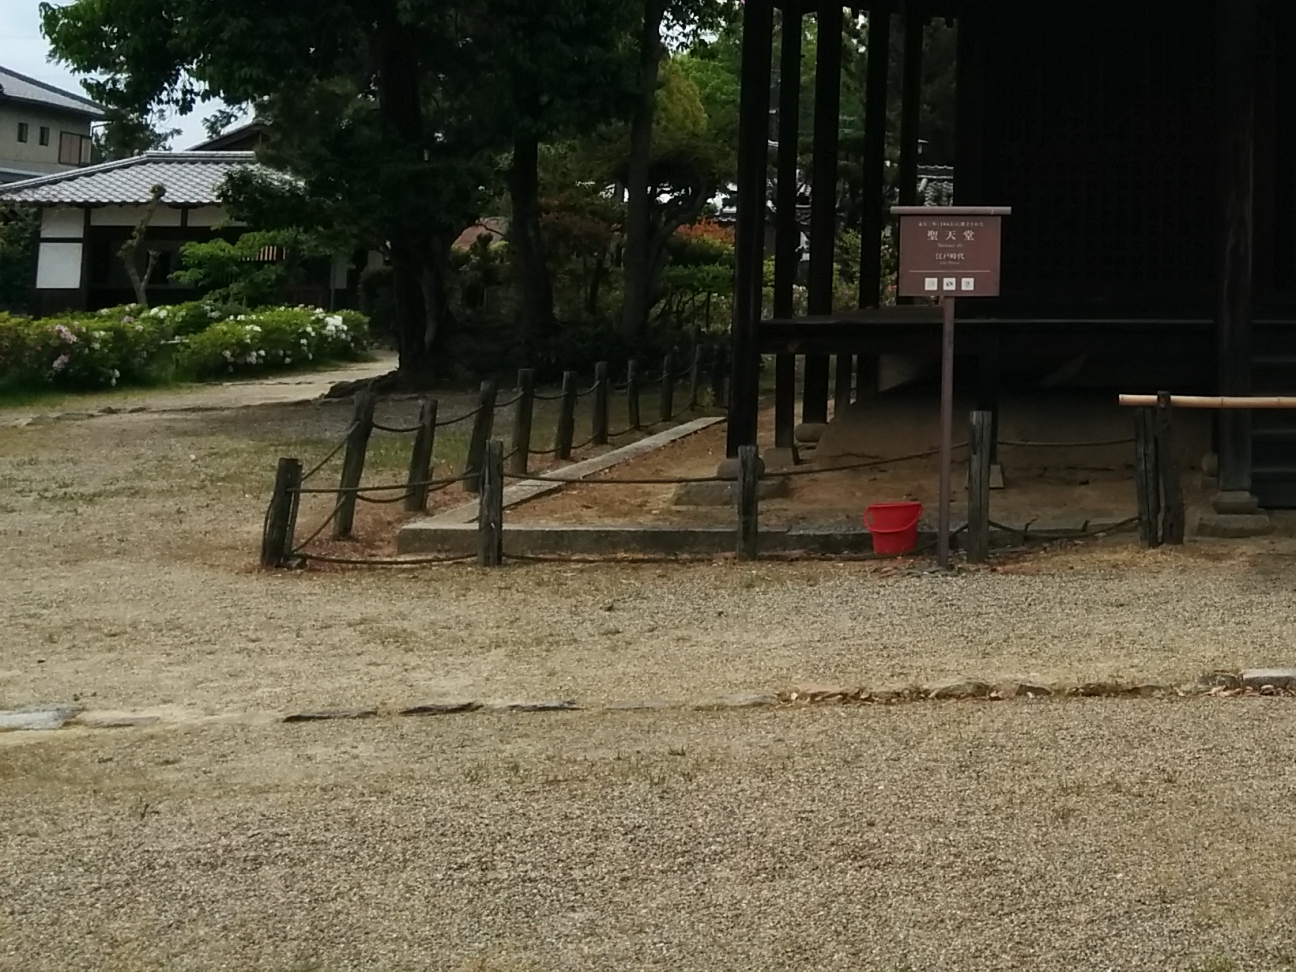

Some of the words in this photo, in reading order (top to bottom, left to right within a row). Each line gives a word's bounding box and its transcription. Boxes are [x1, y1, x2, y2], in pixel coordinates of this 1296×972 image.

[926, 229, 975, 241] 聖天堂
[935, 252, 965, 260] 江戸時代
